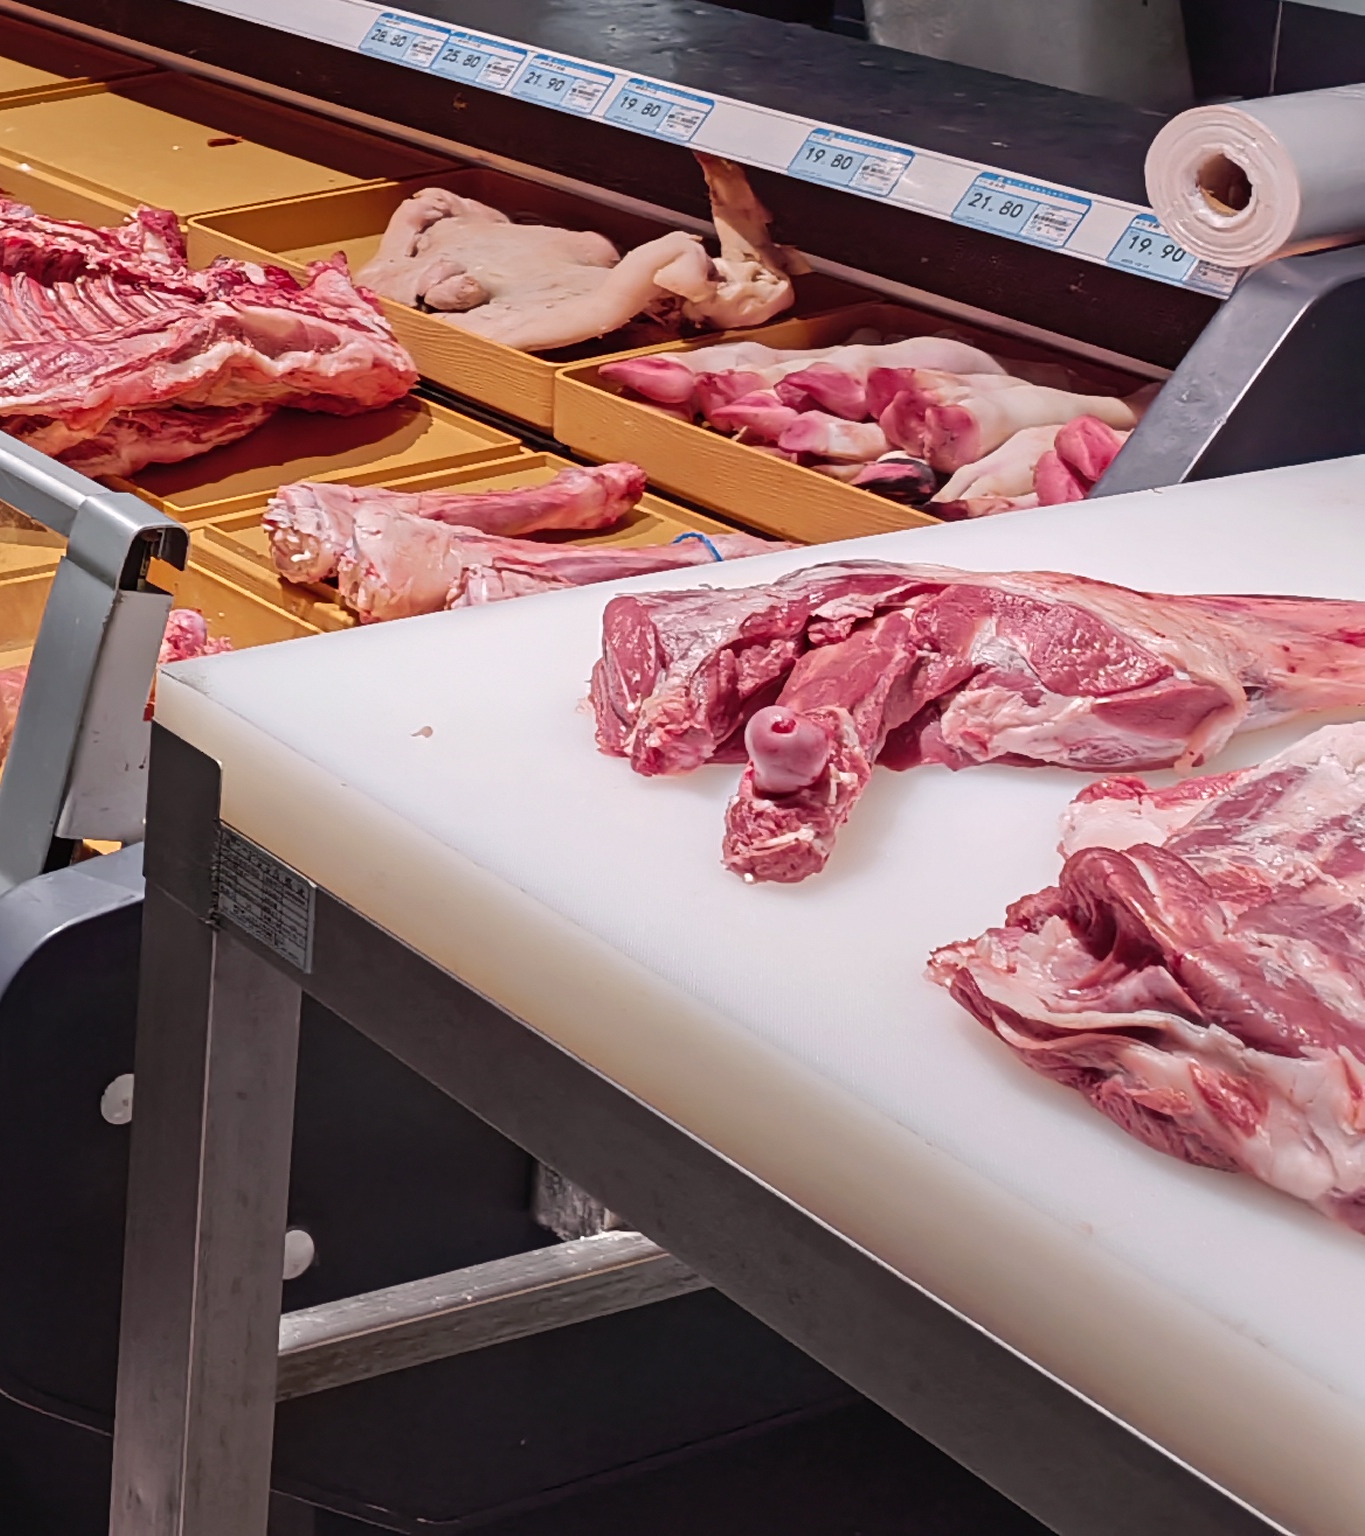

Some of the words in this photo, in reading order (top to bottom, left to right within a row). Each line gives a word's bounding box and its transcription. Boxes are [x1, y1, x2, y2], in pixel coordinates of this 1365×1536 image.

[442, 48, 481, 68] 25.80
[523, 72, 566, 92] 21.90
[620, 95, 662, 118] 19.80
[805, 146, 854, 170] 19.80
[967, 192, 1024, 218] 21.80
[1128, 235, 1187, 263] 19.90
